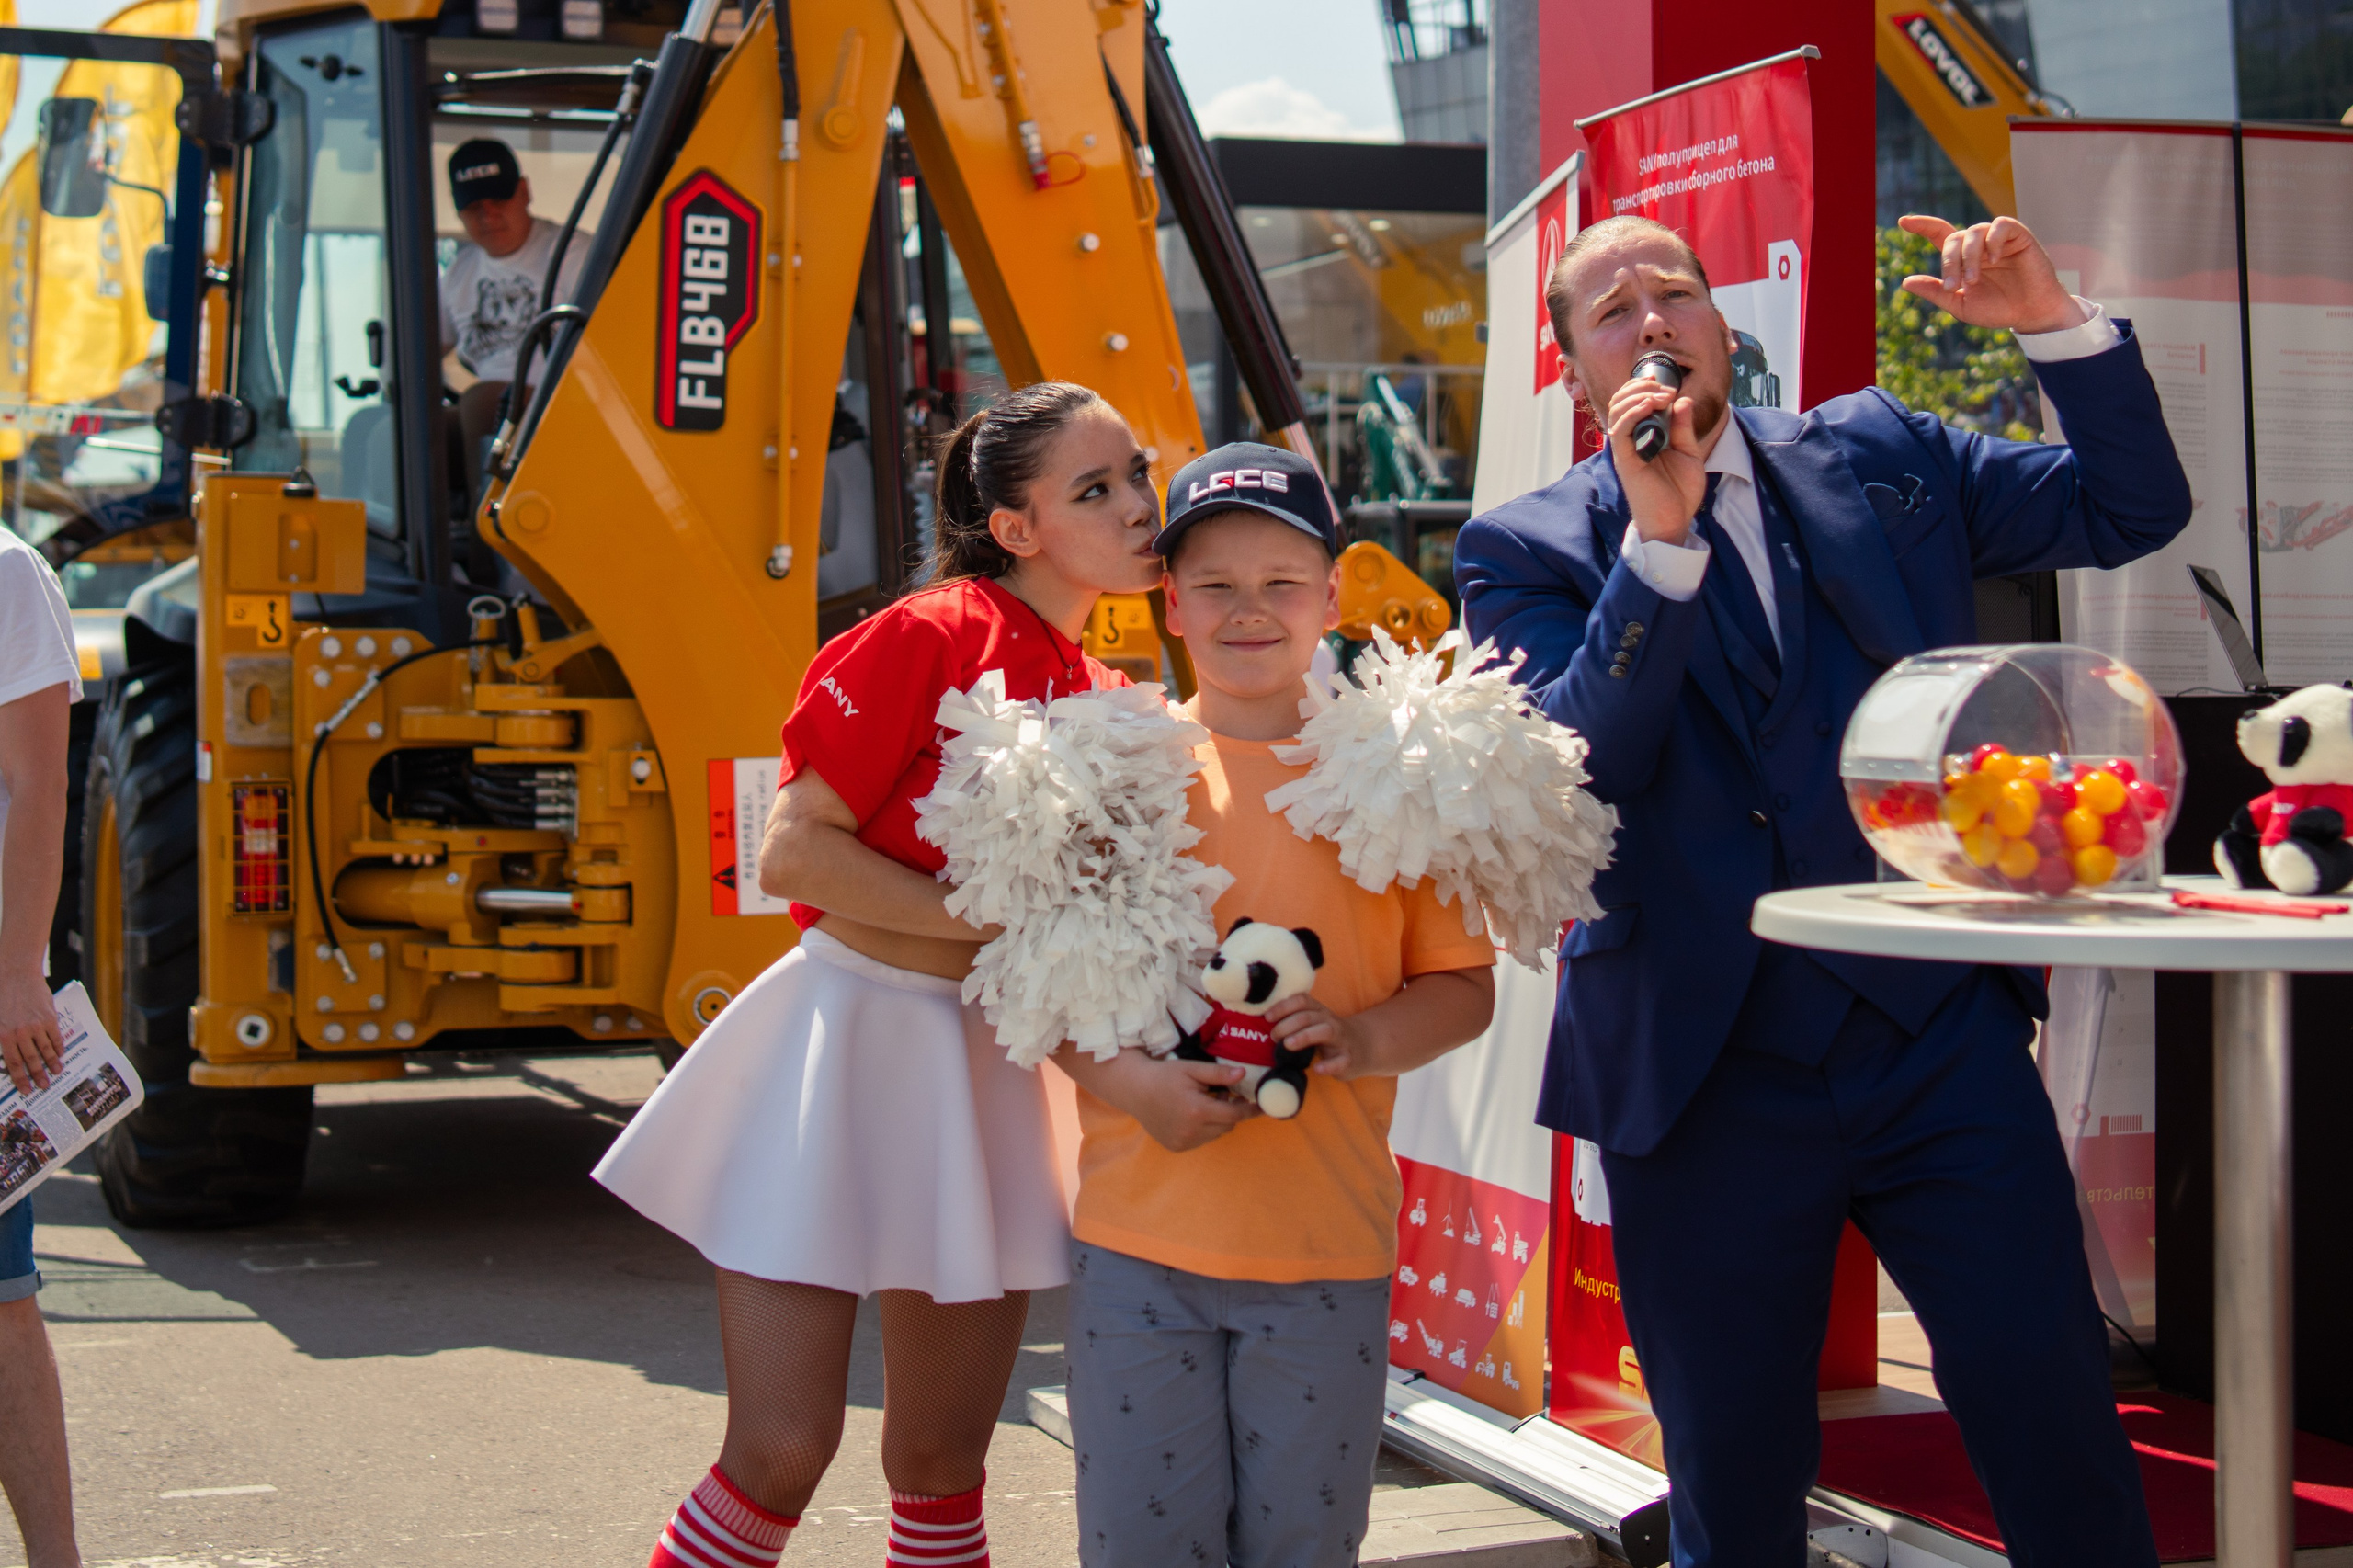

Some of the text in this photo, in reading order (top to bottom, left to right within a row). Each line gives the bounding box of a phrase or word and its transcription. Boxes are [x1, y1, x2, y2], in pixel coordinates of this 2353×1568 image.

[1907, 17, 1978, 107] LOVOL
[1639, 134, 1738, 176] SANY полуприцеп для
[1613, 156, 1775, 215] транспортировки сборного бетона
[677, 213, 730, 410] FLB468
[1189, 470, 1288, 502] LGCE
[1230, 1026, 1268, 1043] SANY
[1574, 1267, 1620, 1304] Индустр
